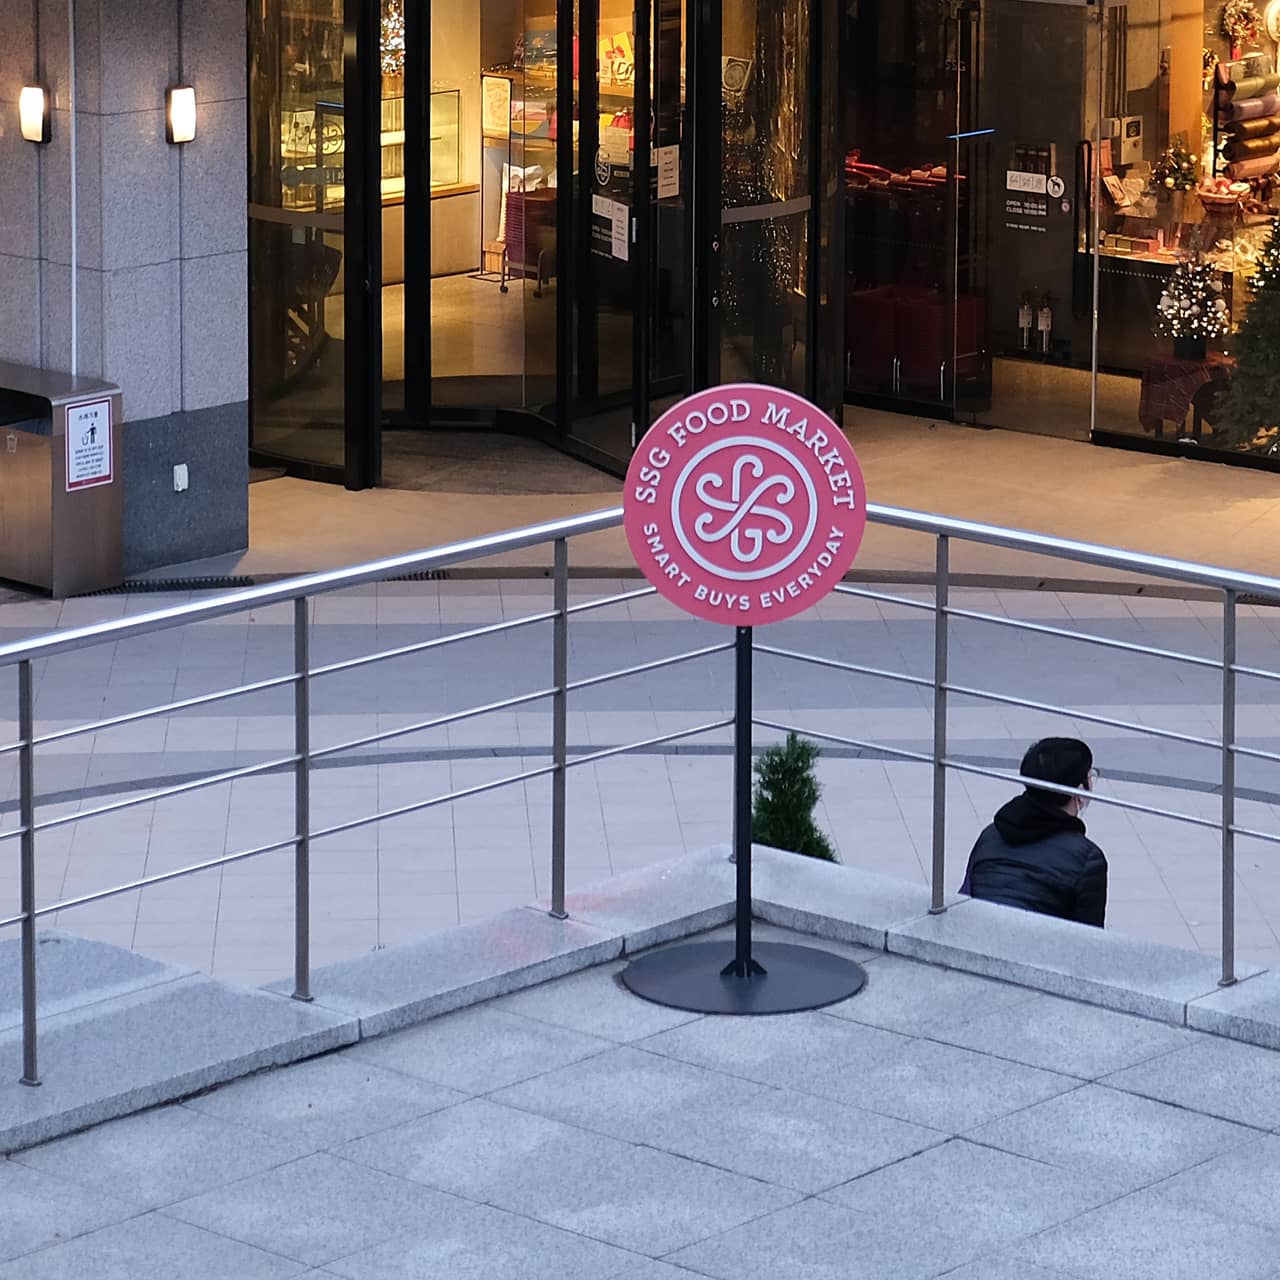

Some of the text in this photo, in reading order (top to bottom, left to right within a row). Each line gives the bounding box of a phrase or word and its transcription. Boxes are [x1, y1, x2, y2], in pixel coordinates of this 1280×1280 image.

[634, 399, 856, 510] SSG FOOD MARKET
[643, 522, 845, 611] SMART BUYS EVERYDAY
